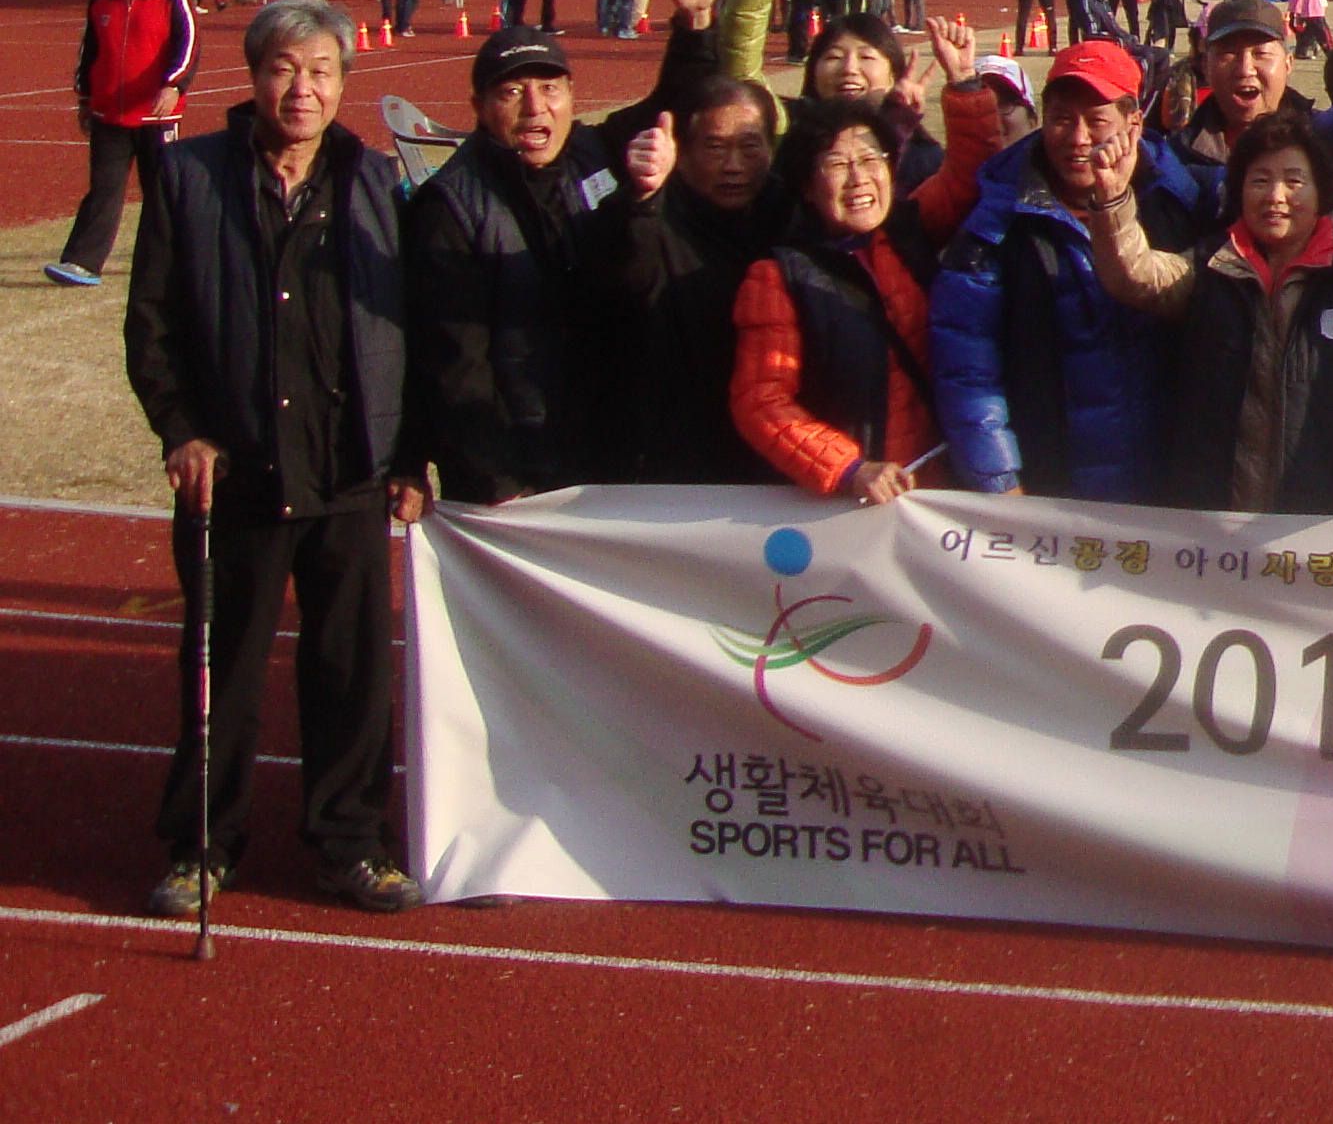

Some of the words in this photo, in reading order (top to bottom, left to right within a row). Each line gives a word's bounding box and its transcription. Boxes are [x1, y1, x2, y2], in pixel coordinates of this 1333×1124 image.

[940, 527, 1150, 575] 어르신공경
[684, 752, 1006, 840] 생활체육대회
[690, 819, 852, 862] SPORTS
[861, 827, 941, 867] FOR
[950, 839, 1026, 874] ALL
